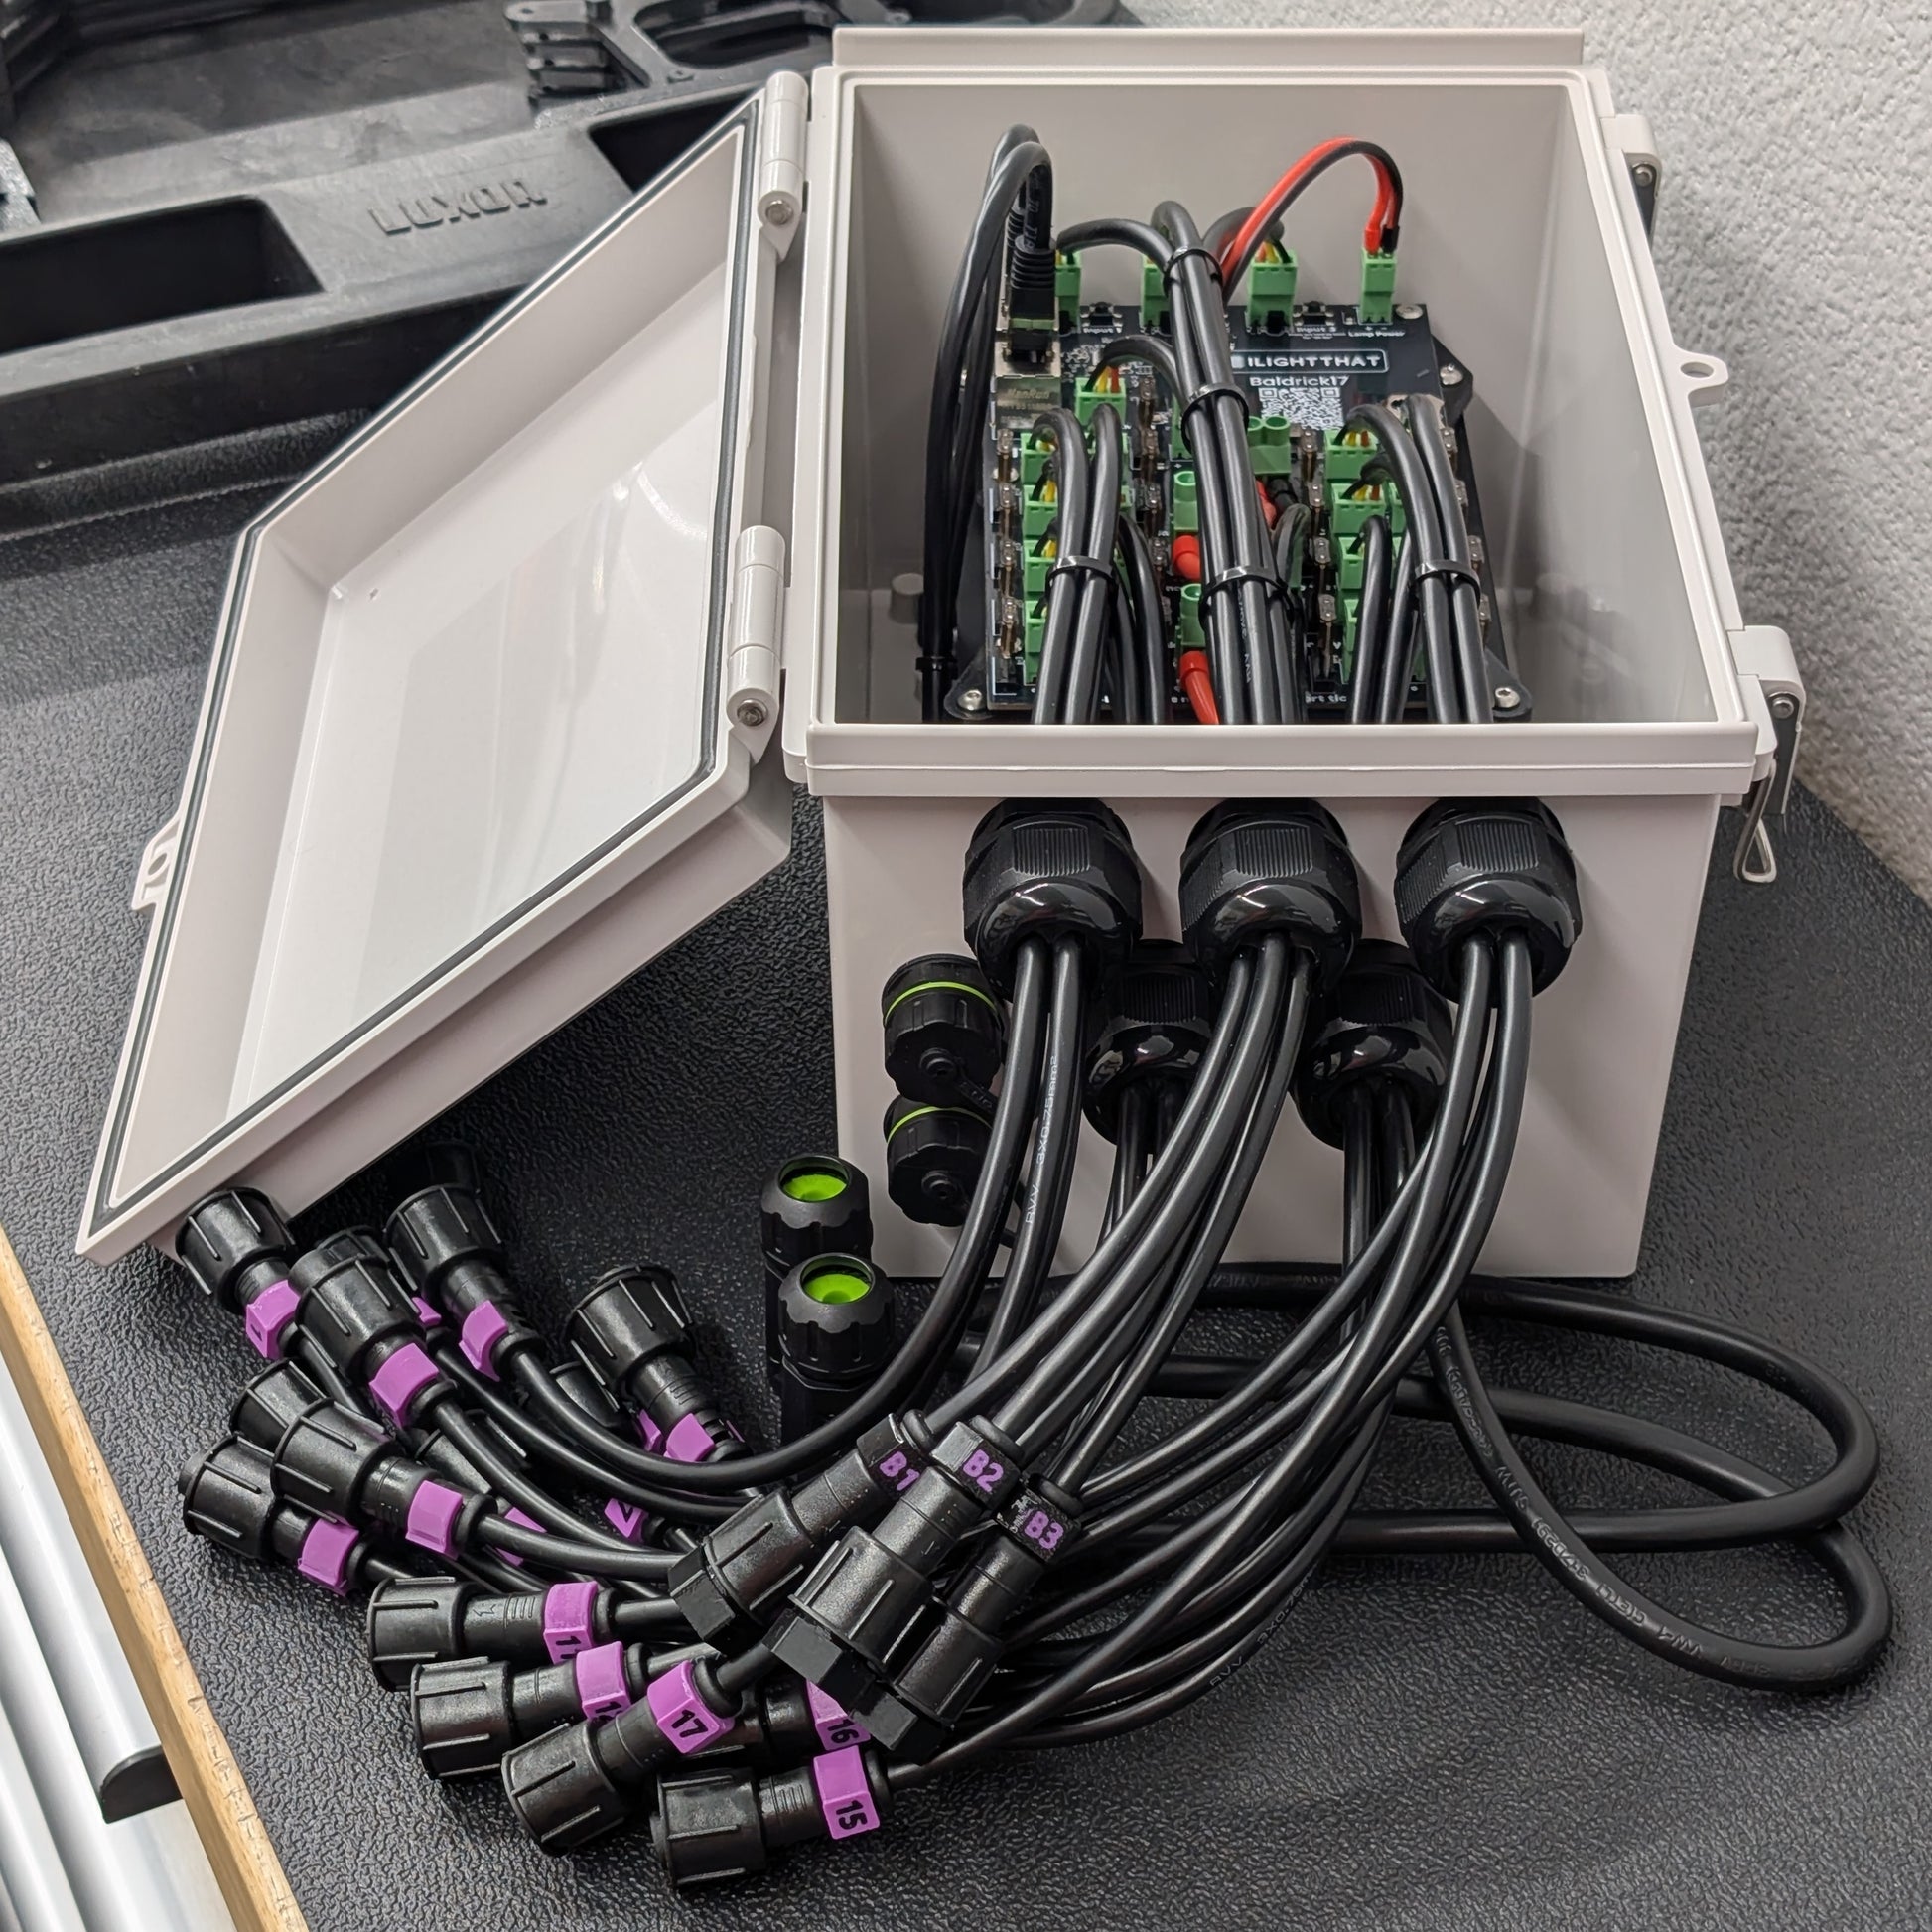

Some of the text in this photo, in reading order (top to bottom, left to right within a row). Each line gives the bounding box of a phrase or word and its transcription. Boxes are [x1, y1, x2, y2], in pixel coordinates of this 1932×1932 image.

[1248, 355, 1381, 368] ILIGHTTHAT
[1249, 375, 1350, 387] Baldrick17
[879, 1450, 920, 1491] B1
[962, 1449, 1004, 1493] B2
[1024, 1510, 1064, 1550] B3
[671, 1709, 709, 1738] 17
[827, 1718, 860, 1744] 16
[835, 1799, 868, 1831] 15
